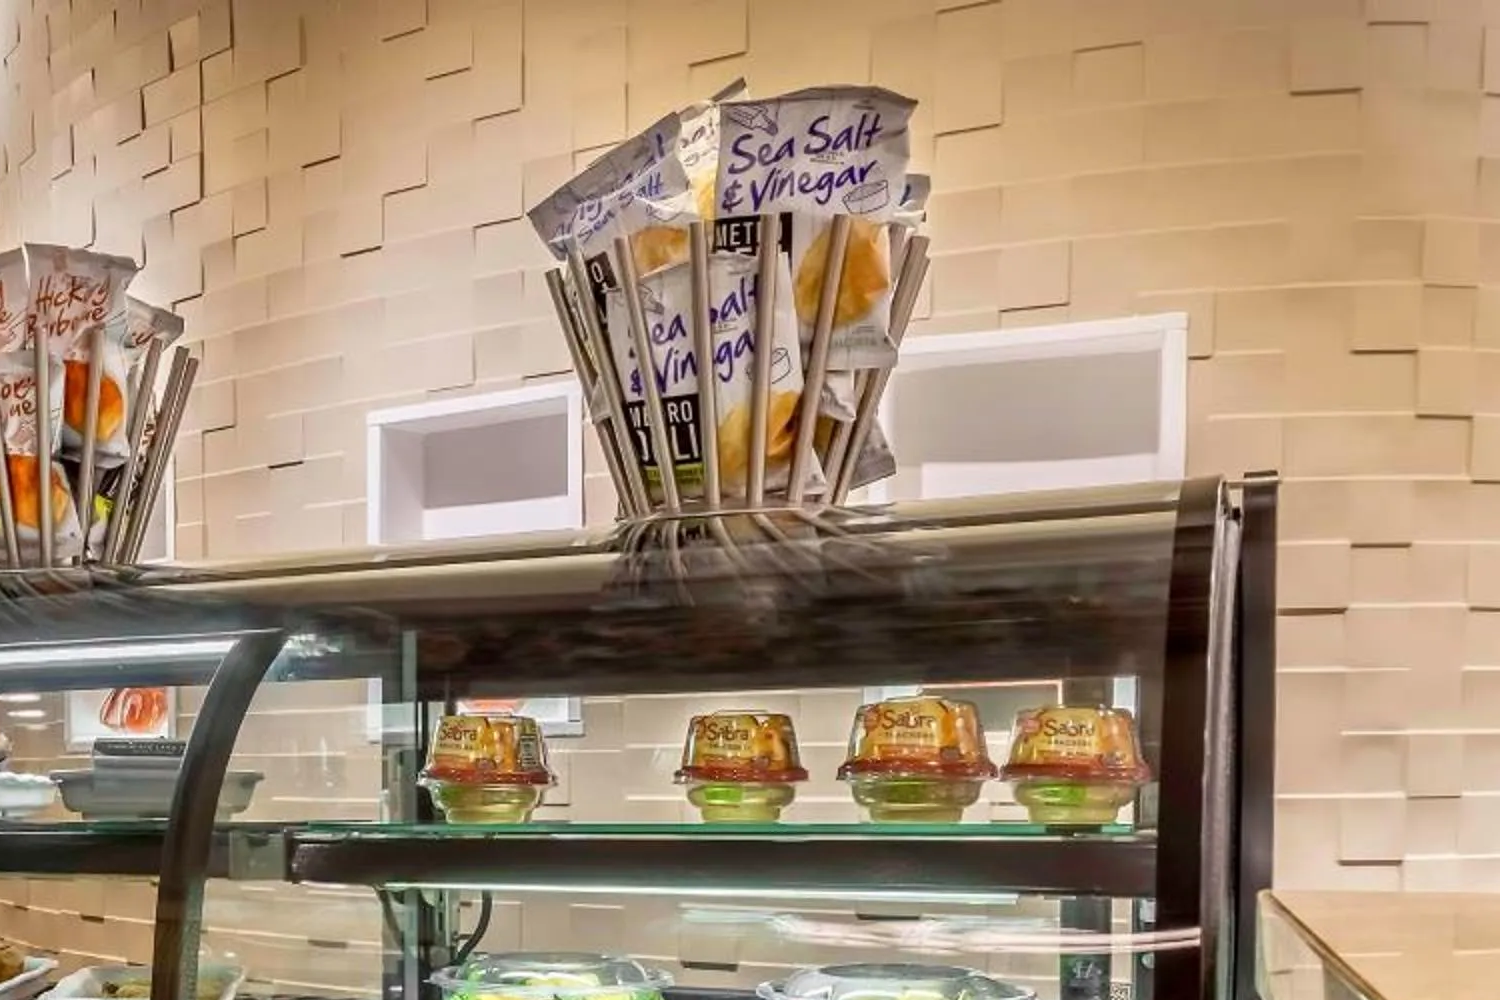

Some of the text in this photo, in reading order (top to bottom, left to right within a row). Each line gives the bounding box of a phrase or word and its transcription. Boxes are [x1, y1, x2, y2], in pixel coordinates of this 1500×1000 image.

[727, 133, 795, 175] Sea
[803, 112, 883, 155] Salt
[750, 159, 878, 212] Vinegar
[628, 399, 694, 428] MERO
[883, 708, 936, 730] Sabra
